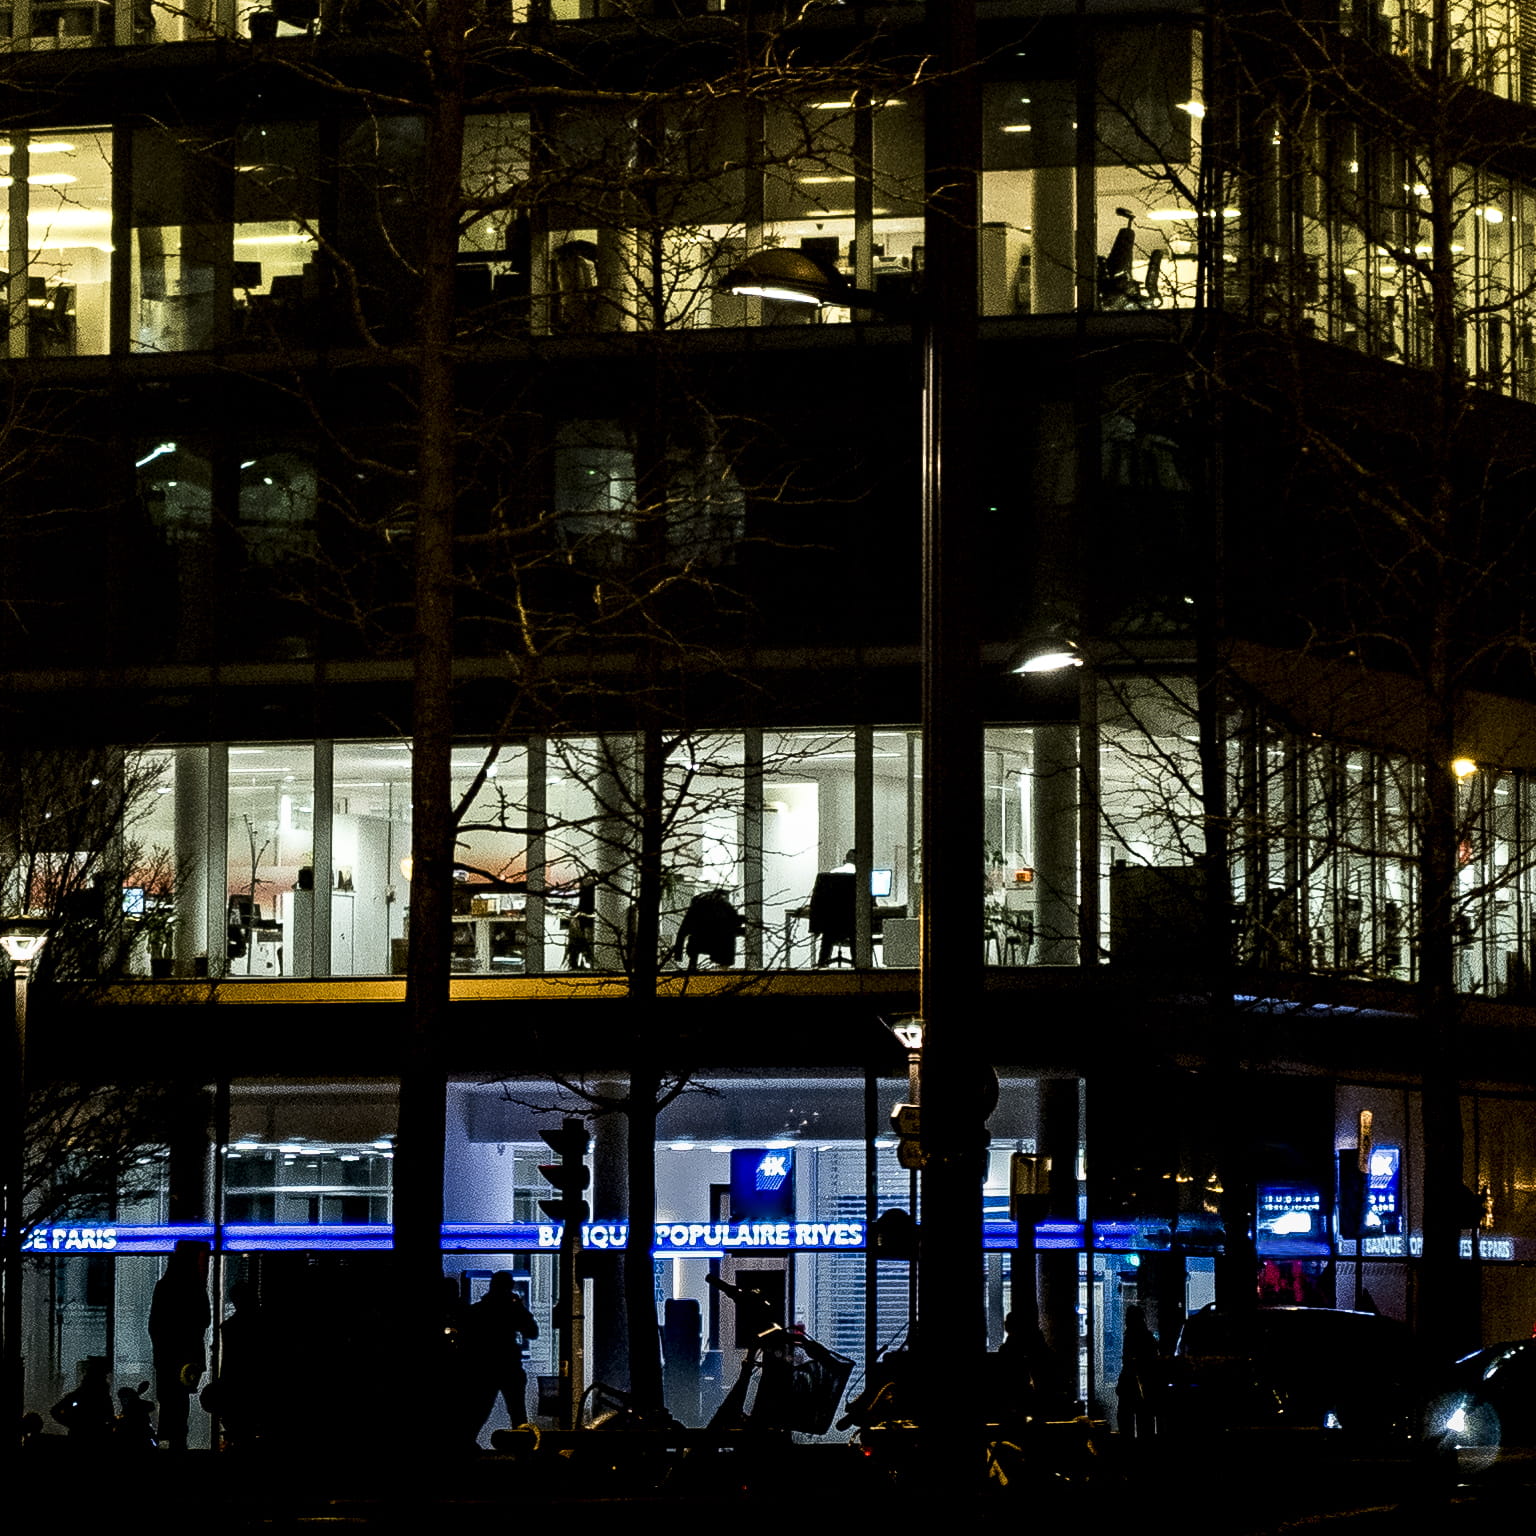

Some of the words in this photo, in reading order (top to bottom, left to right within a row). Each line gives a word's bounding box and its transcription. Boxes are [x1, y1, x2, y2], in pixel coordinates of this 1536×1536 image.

[52, 1227, 117, 1249] PARIS
[655, 1224, 790, 1247] POPULAIRE
[795, 1224, 863, 1245] RIVES
